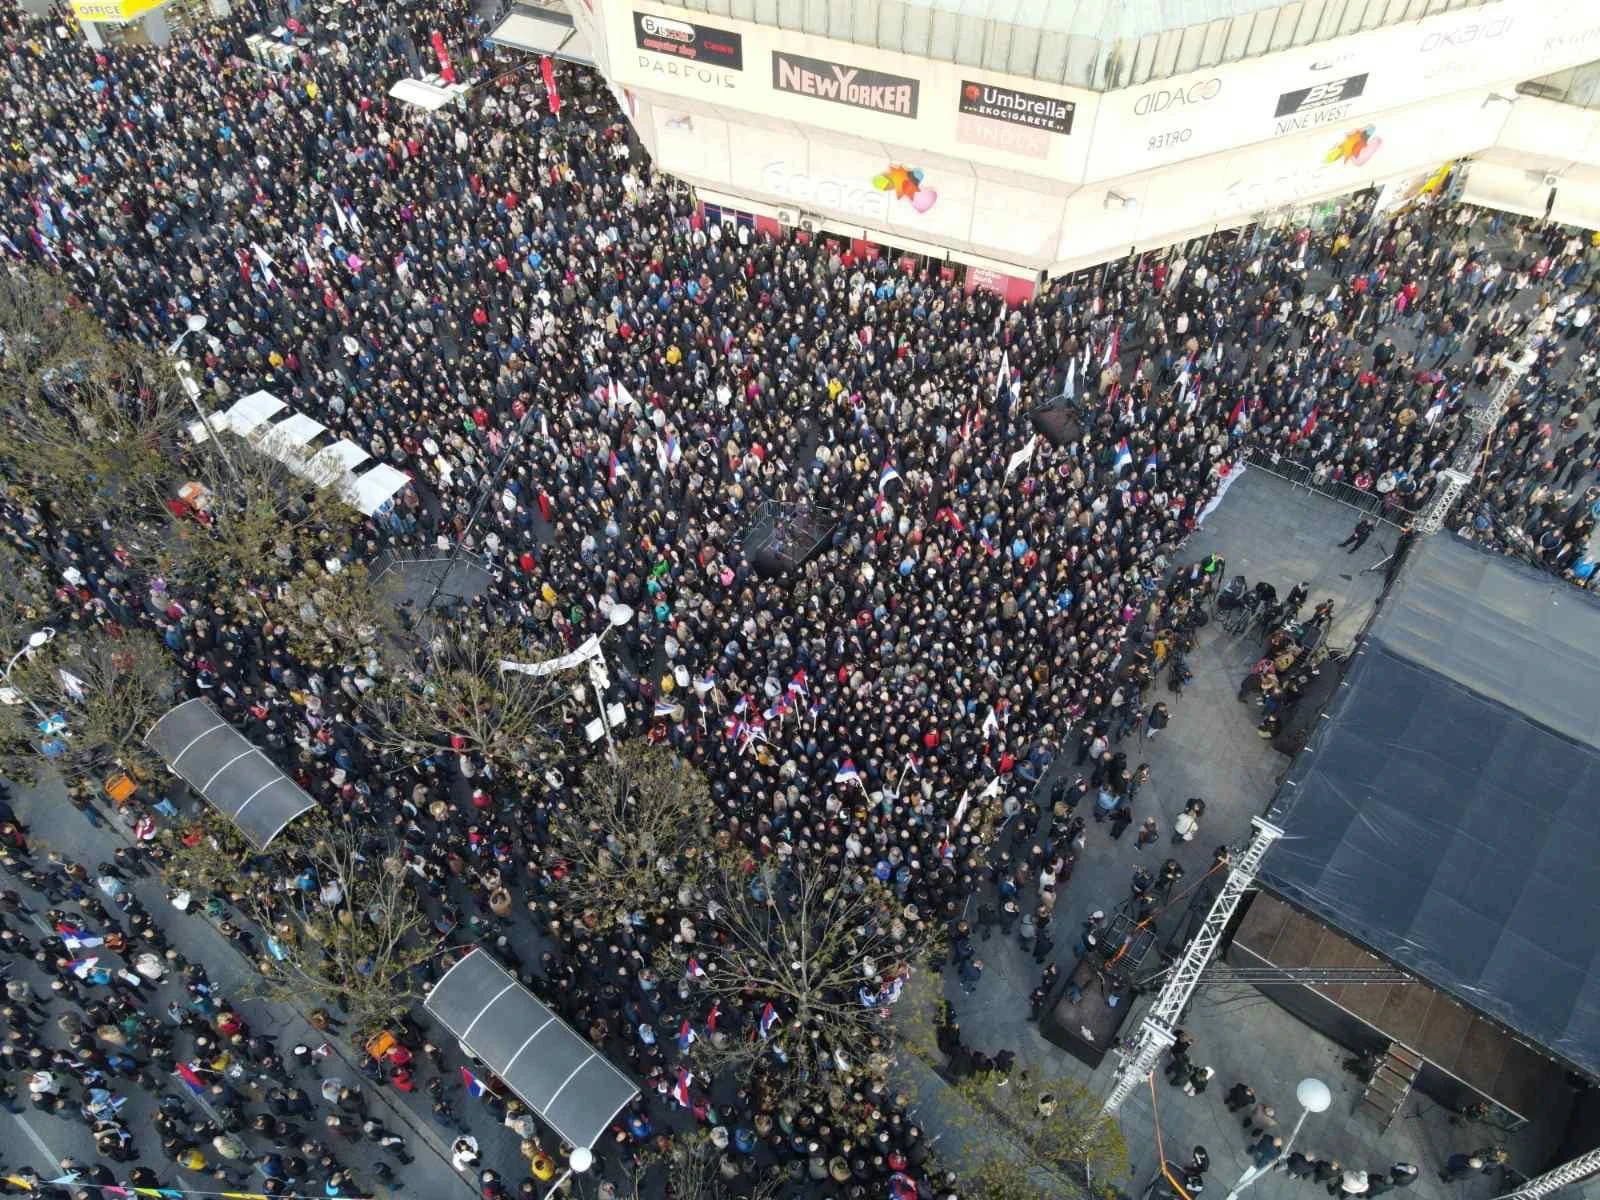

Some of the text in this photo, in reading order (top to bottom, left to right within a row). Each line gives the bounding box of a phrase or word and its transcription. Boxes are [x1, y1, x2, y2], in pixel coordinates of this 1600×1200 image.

[80, 5, 120, 16] OFFICE
[638, 55, 736, 88] PARFOIS
[1275, 114, 1310, 134] NINE
[1314, 103, 1353, 125] WEST
